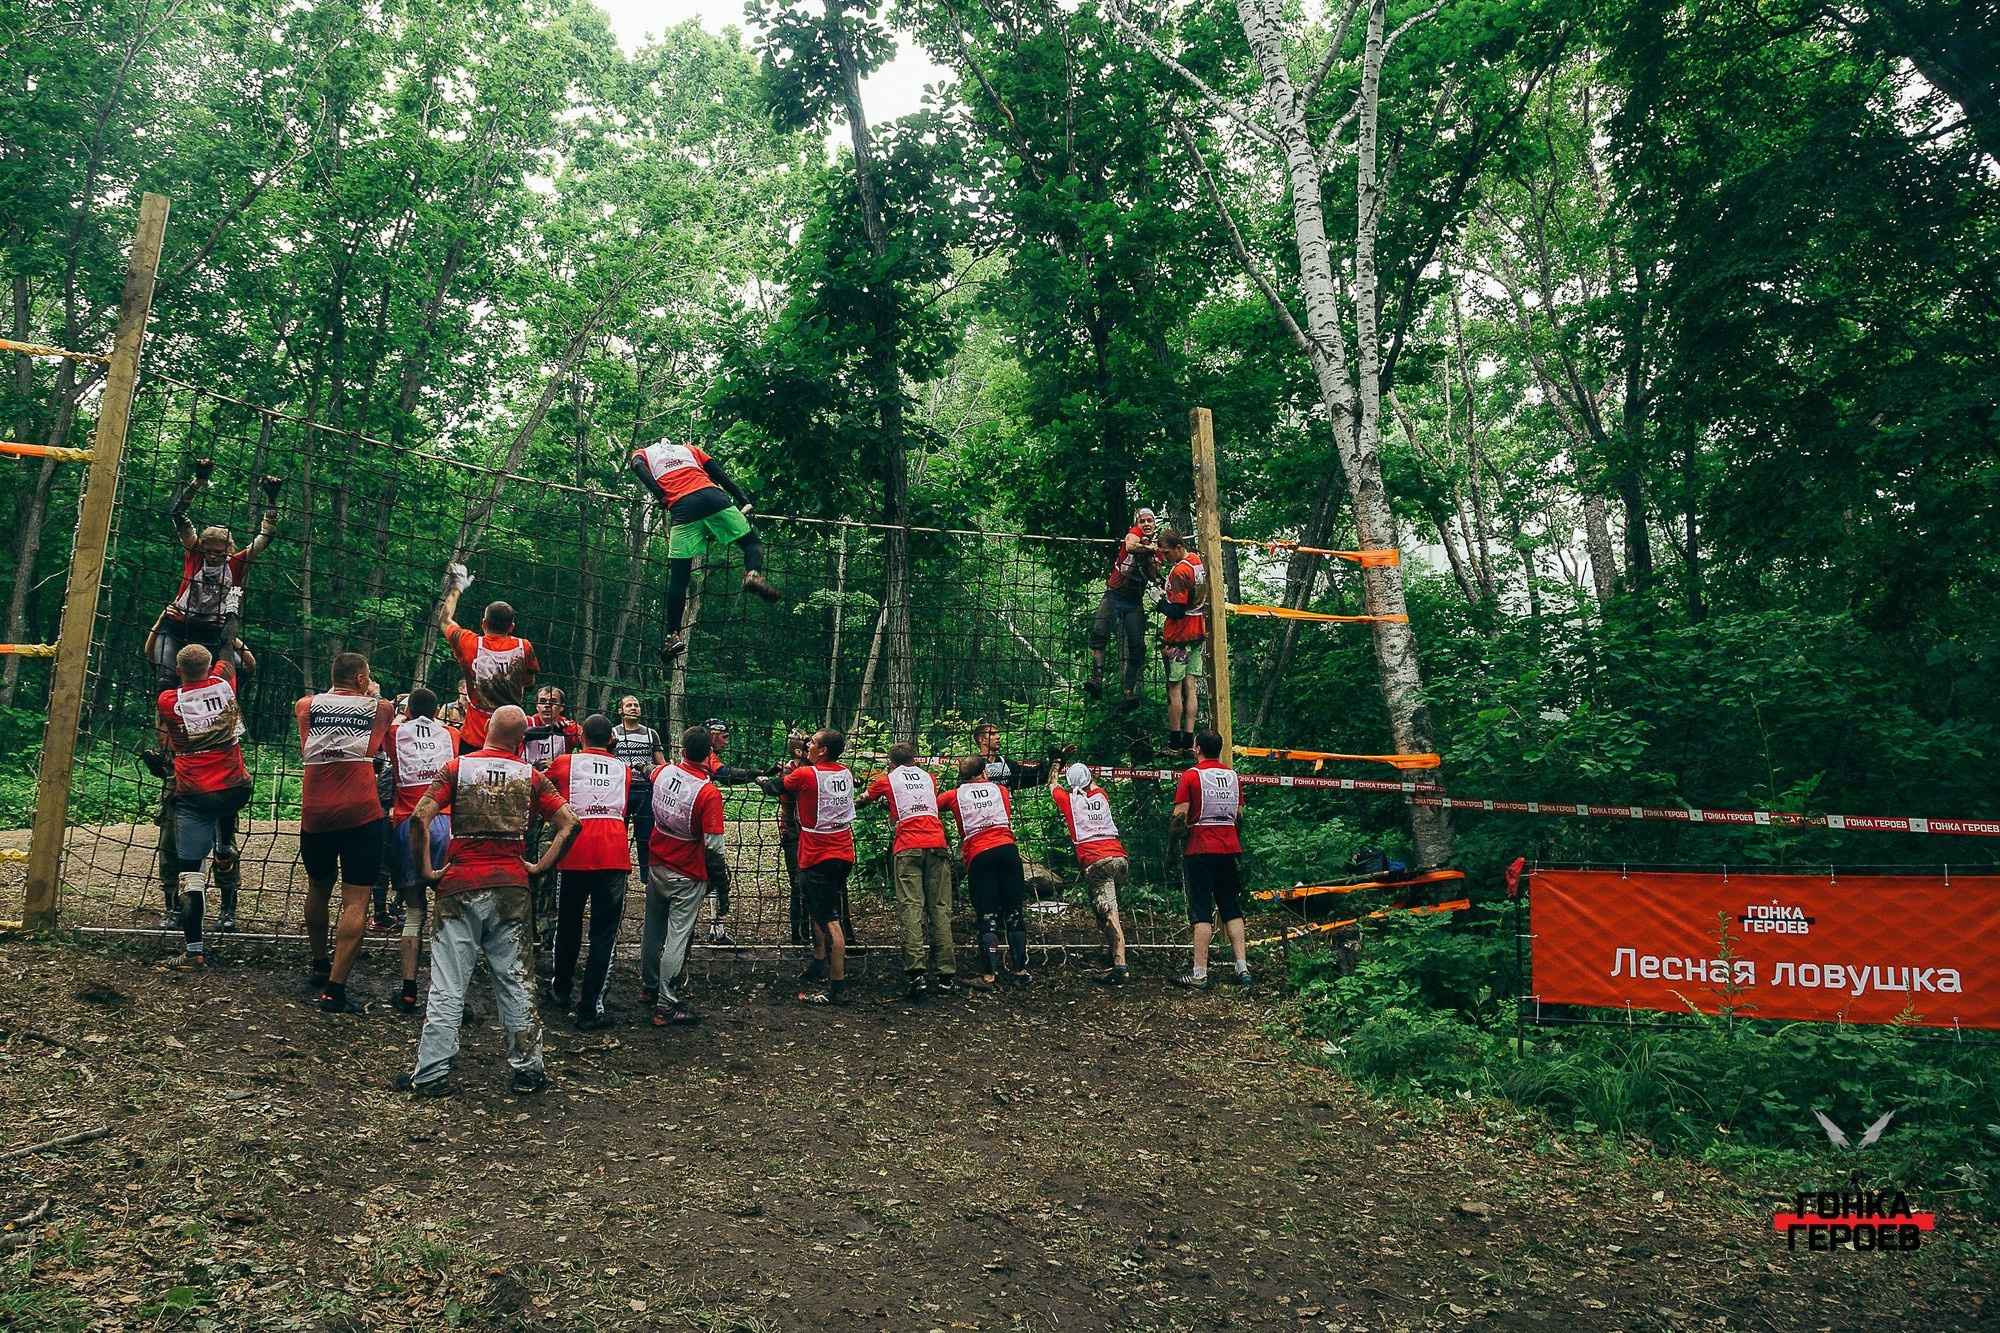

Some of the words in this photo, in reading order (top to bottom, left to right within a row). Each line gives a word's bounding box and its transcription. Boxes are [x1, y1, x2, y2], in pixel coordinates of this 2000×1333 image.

[203, 697, 223, 711] 111
[314, 716, 369, 726] ИНСТРУКТОР
[416, 725, 431, 738] 111
[593, 762, 609, 775] 111
[487, 770, 507, 786] 111
[901, 772, 920, 781] 110
[1255, 776, 1280, 785] ГЕРОЕВ
[590, 779, 610, 787] 1106
[832, 780, 847, 792] 110
[1216, 777, 1228, 788] 111
[1294, 778, 1316, 786] ГОНКА
[1316, 779, 1340, 788] ГЕРОЕВ
[1377, 782, 1401, 790] ГЕРОЕВ
[971, 789, 990, 799] 110
[1086, 801, 1101, 810] 110
[1539, 804, 1556, 812] ГОНКА
[1607, 808, 1630, 816] ГЕРОЕВ
[1644, 809, 1664, 817] ГОНКА
[1664, 810, 1688, 818] ГЕРОЕВ
[1704, 812, 1726, 820] ГОНКА
[1726, 813, 1753, 822] ГЕРОЕВ
[1845, 818, 1874, 827] ГОНКА
[1874, 820, 1908, 829] ГЕРОЕВ
[1930, 821, 1961, 831] ГОНКА
[1961, 823, 2000, 833] ГЕРОЕВ
[1747, 905, 1805, 920] ГОНКА
[1743, 919, 1809, 934] ГЕРОЕВ
[1610, 947, 1756, 985] Лесная
[1771, 962, 1963, 996] ловушка
